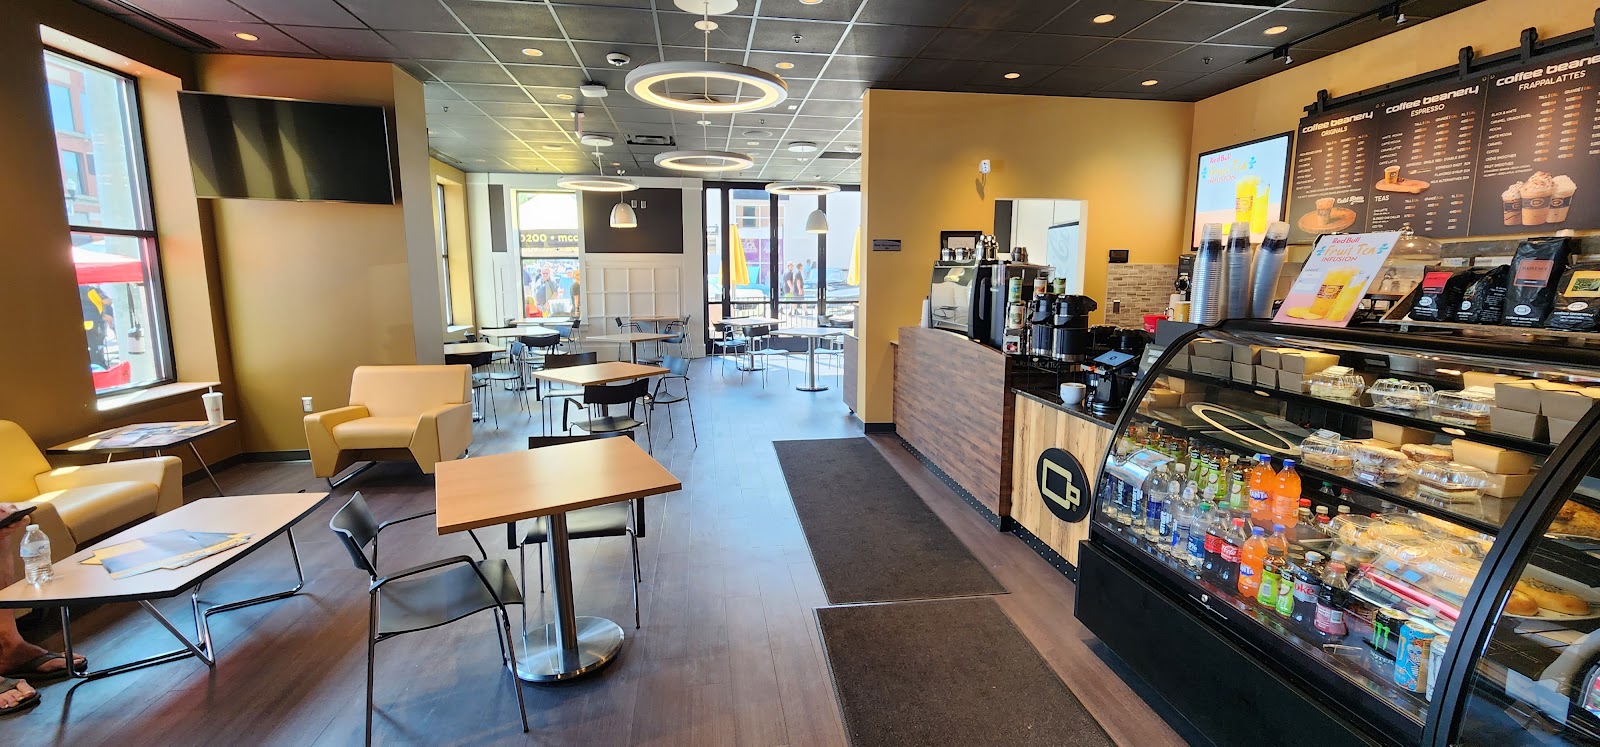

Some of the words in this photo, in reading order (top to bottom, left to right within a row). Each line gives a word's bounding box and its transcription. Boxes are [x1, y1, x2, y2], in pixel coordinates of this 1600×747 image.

[1496, 68, 1544, 86] coffee
[1518, 70, 1587, 91] FRAPPALATTES
[1386, 99, 1422, 114] coffee
[1423, 86, 1479, 105] beanery
[1411, 103, 1446, 117] ESPRESSO
[1302, 121, 1329, 133] coffee
[1330, 111, 1374, 127] beanery
[1321, 126, 1349, 137] ORIGINALS
[1375, 194, 1390, 202] TEAS
[1324, 245, 1354, 257] Fruit
[1355, 243, 1377, 256] Tea
